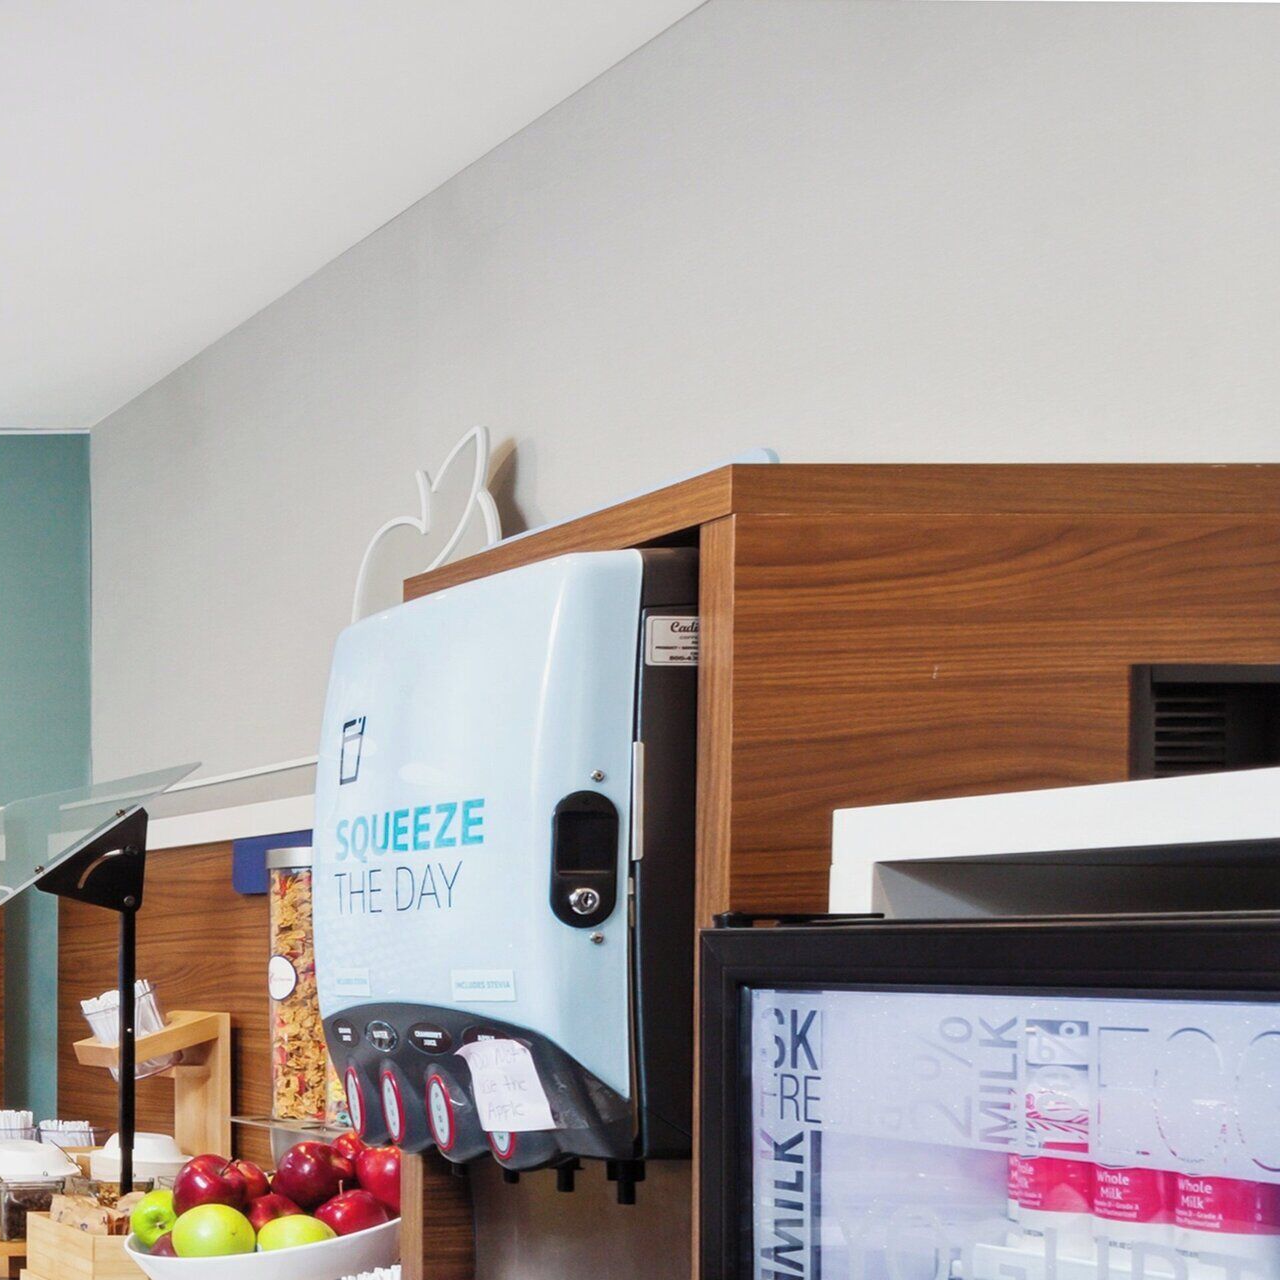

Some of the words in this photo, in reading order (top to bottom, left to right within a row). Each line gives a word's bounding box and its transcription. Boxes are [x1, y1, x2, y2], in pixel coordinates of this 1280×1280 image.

[335, 797, 486, 864] SQUEEZE
[334, 865, 383, 915] THE
[395, 860, 463, 911] DAY
[1096, 1169, 1130, 1186] Whole
[1100, 1186, 1124, 1200] Milk
[1177, 1178, 1213, 1194] Whole
[1181, 1195, 1205, 1209] Milk
